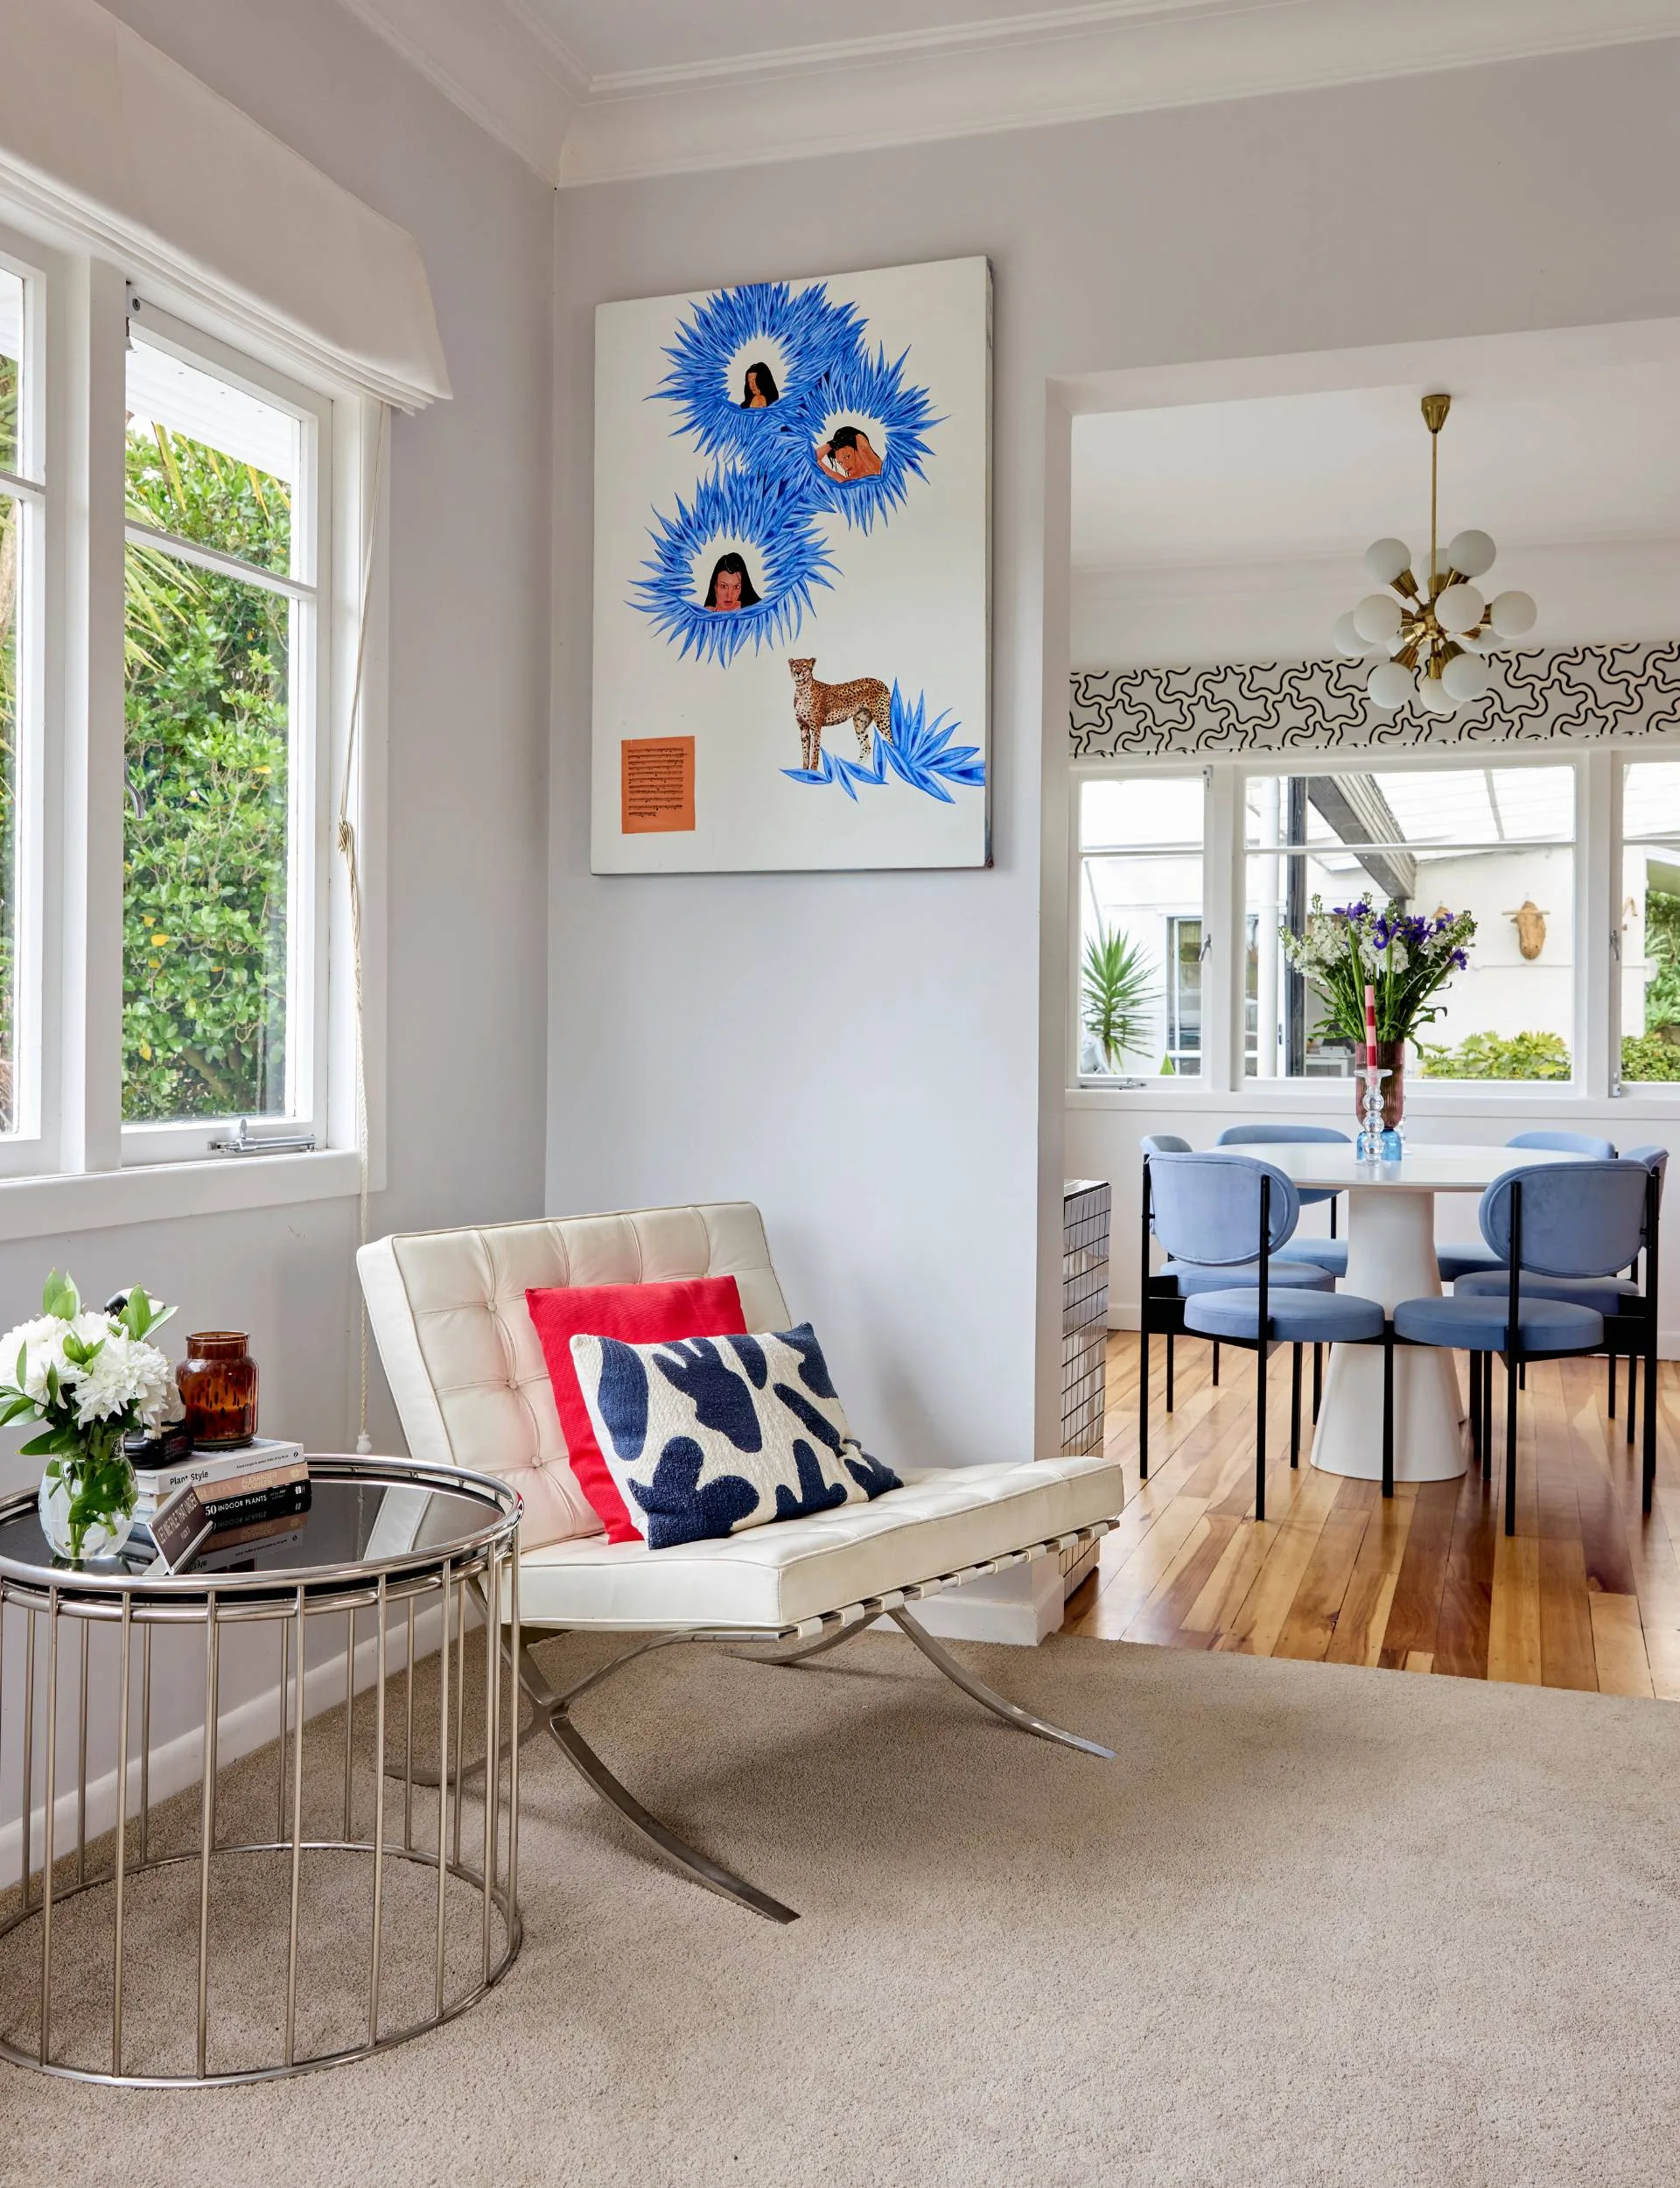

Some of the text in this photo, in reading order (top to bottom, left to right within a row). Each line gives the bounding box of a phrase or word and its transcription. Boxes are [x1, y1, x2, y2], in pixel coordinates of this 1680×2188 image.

[191, 1470, 209, 1482] Style
[241, 1471, 277, 1485] ALEXANDER
[205, 1504, 217, 1516] 50
[218, 1500, 243, 1511] INDOOR
[245, 1495, 268, 1506] PLANTS
[155, 1525, 168, 1545] LET
